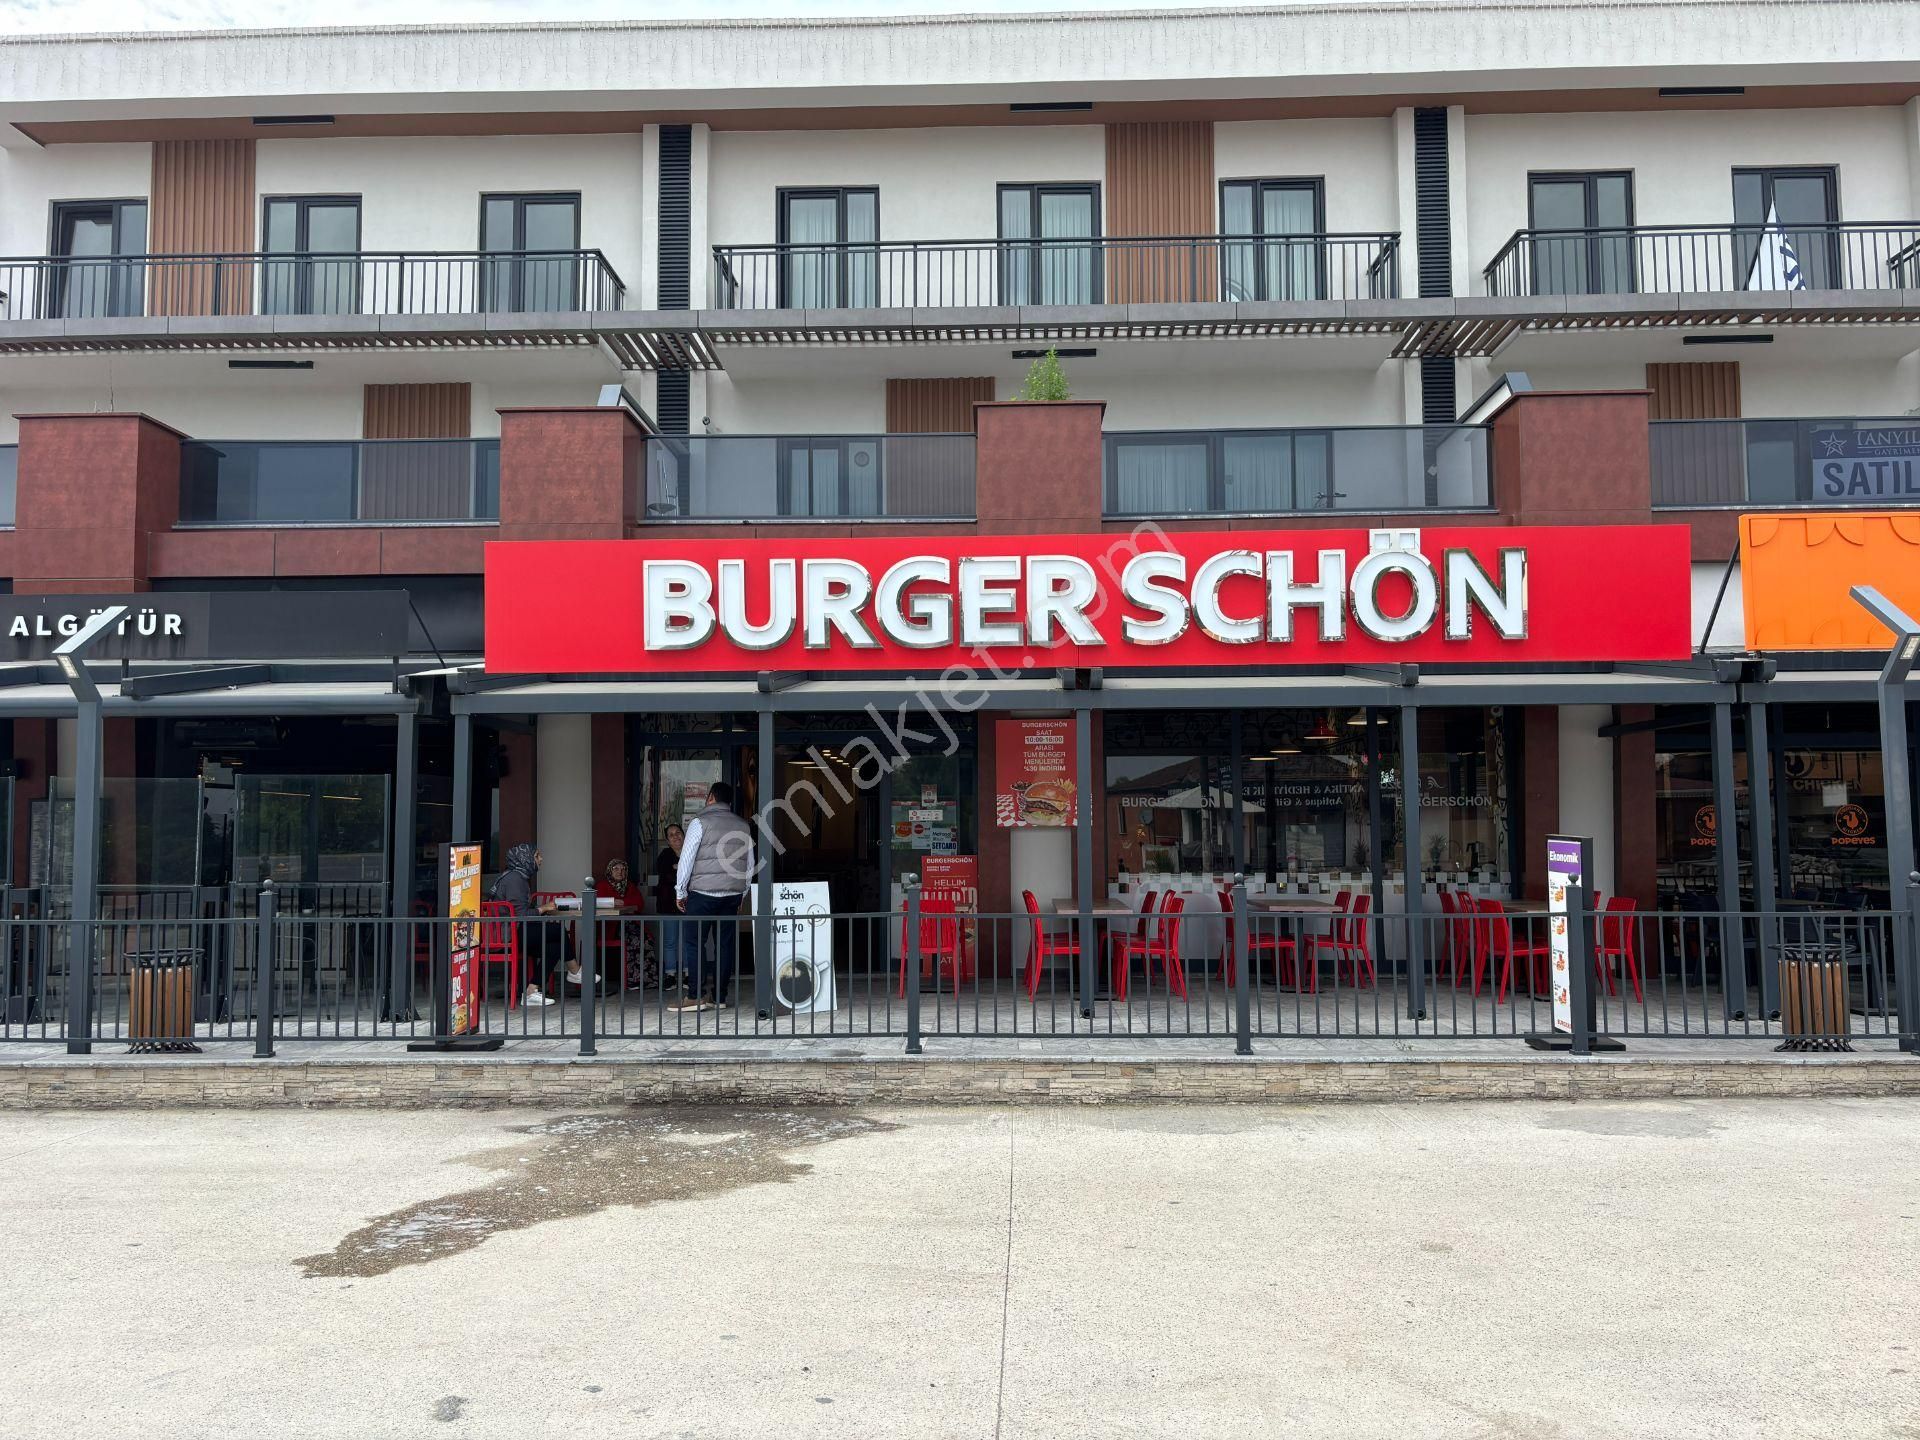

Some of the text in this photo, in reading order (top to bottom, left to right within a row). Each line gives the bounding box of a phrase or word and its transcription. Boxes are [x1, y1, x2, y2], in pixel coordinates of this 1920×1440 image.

[1690, 837, 1717, 846] POPE
[926, 856, 973, 864] BURGERSCHÖN
[1549, 850, 1579, 864] Ekonomik
[780, 889, 804, 900] schön
